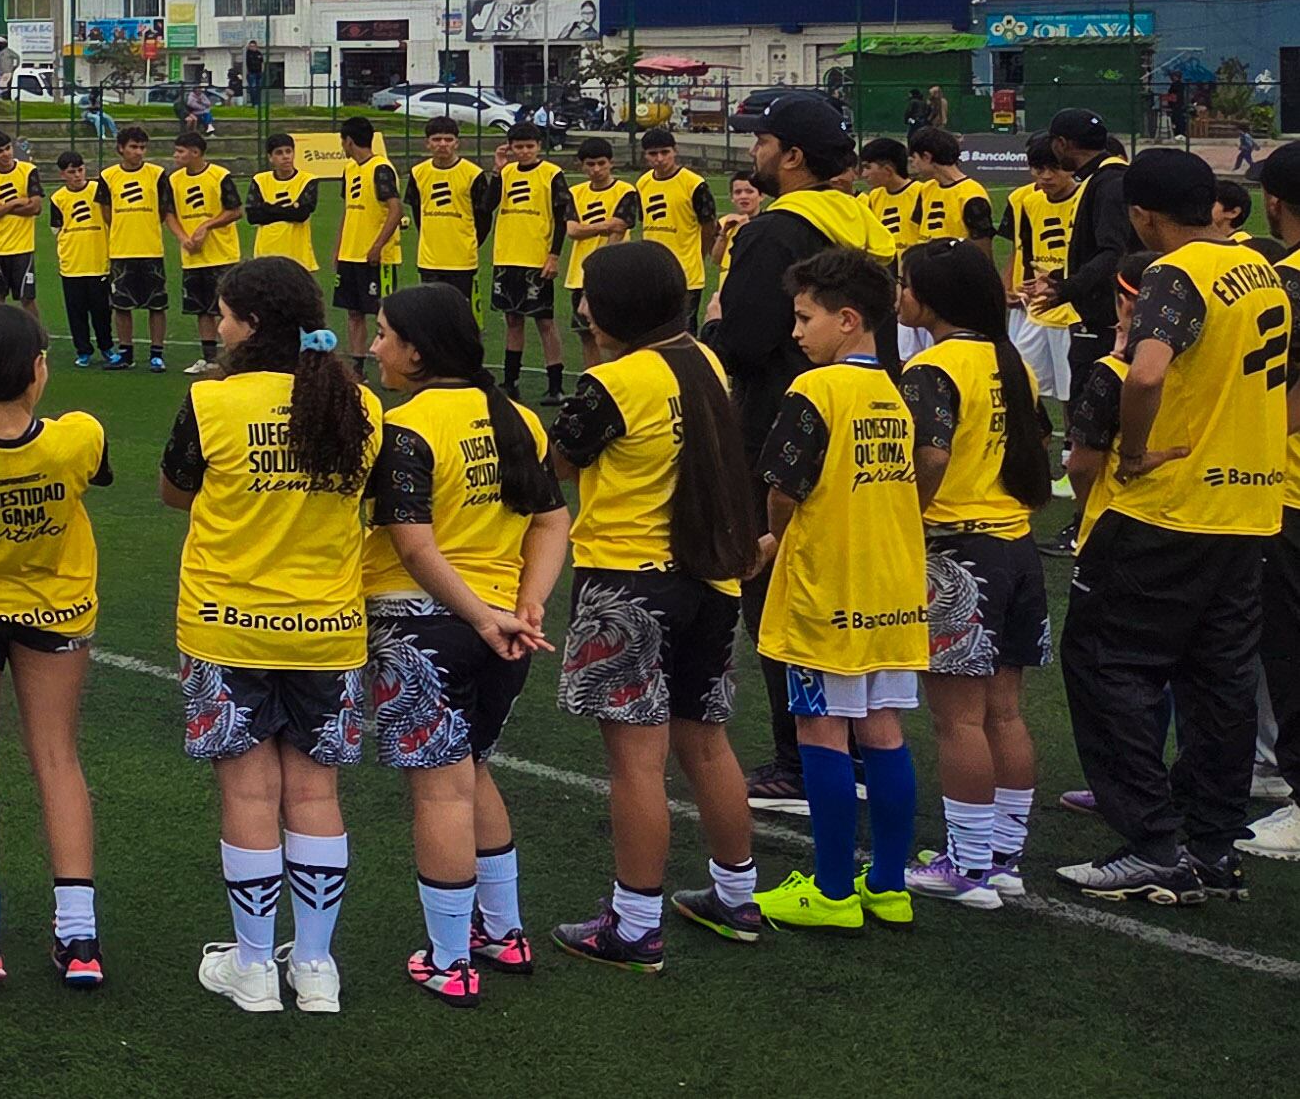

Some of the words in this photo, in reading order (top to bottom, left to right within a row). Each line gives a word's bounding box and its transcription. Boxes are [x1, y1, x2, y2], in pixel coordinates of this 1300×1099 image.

[972, 151, 1028, 161] Bancolom
[1211, 262, 1284, 308] ENTRENA
[248, 422, 292, 447] JUEG
[2, 506, 46, 528] GANA
[224, 606, 363, 633] Bancolombia
